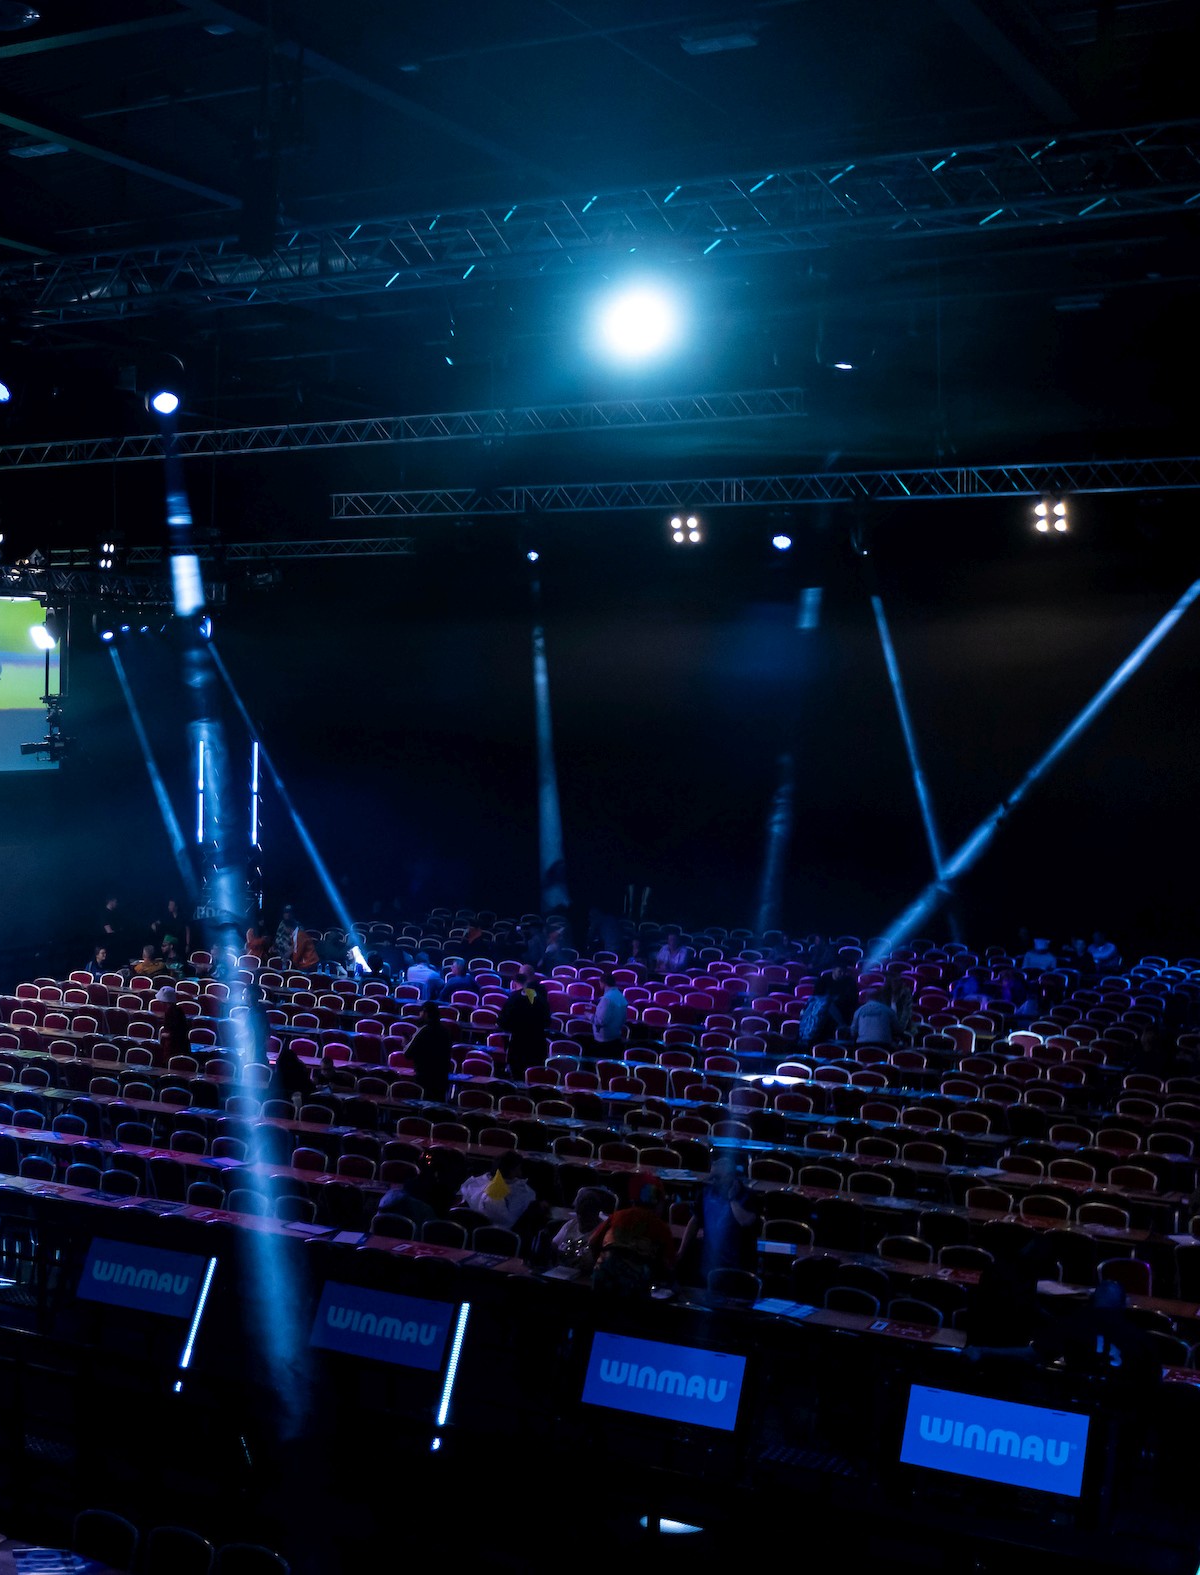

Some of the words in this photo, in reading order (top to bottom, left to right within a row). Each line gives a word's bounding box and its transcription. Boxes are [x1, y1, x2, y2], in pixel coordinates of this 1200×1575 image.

[92, 1259, 191, 1296] WINMAU
[326, 1304, 438, 1346] WINMAU
[600, 1358, 728, 1403] WINMAU
[919, 1414, 1070, 1467] WINMAU
